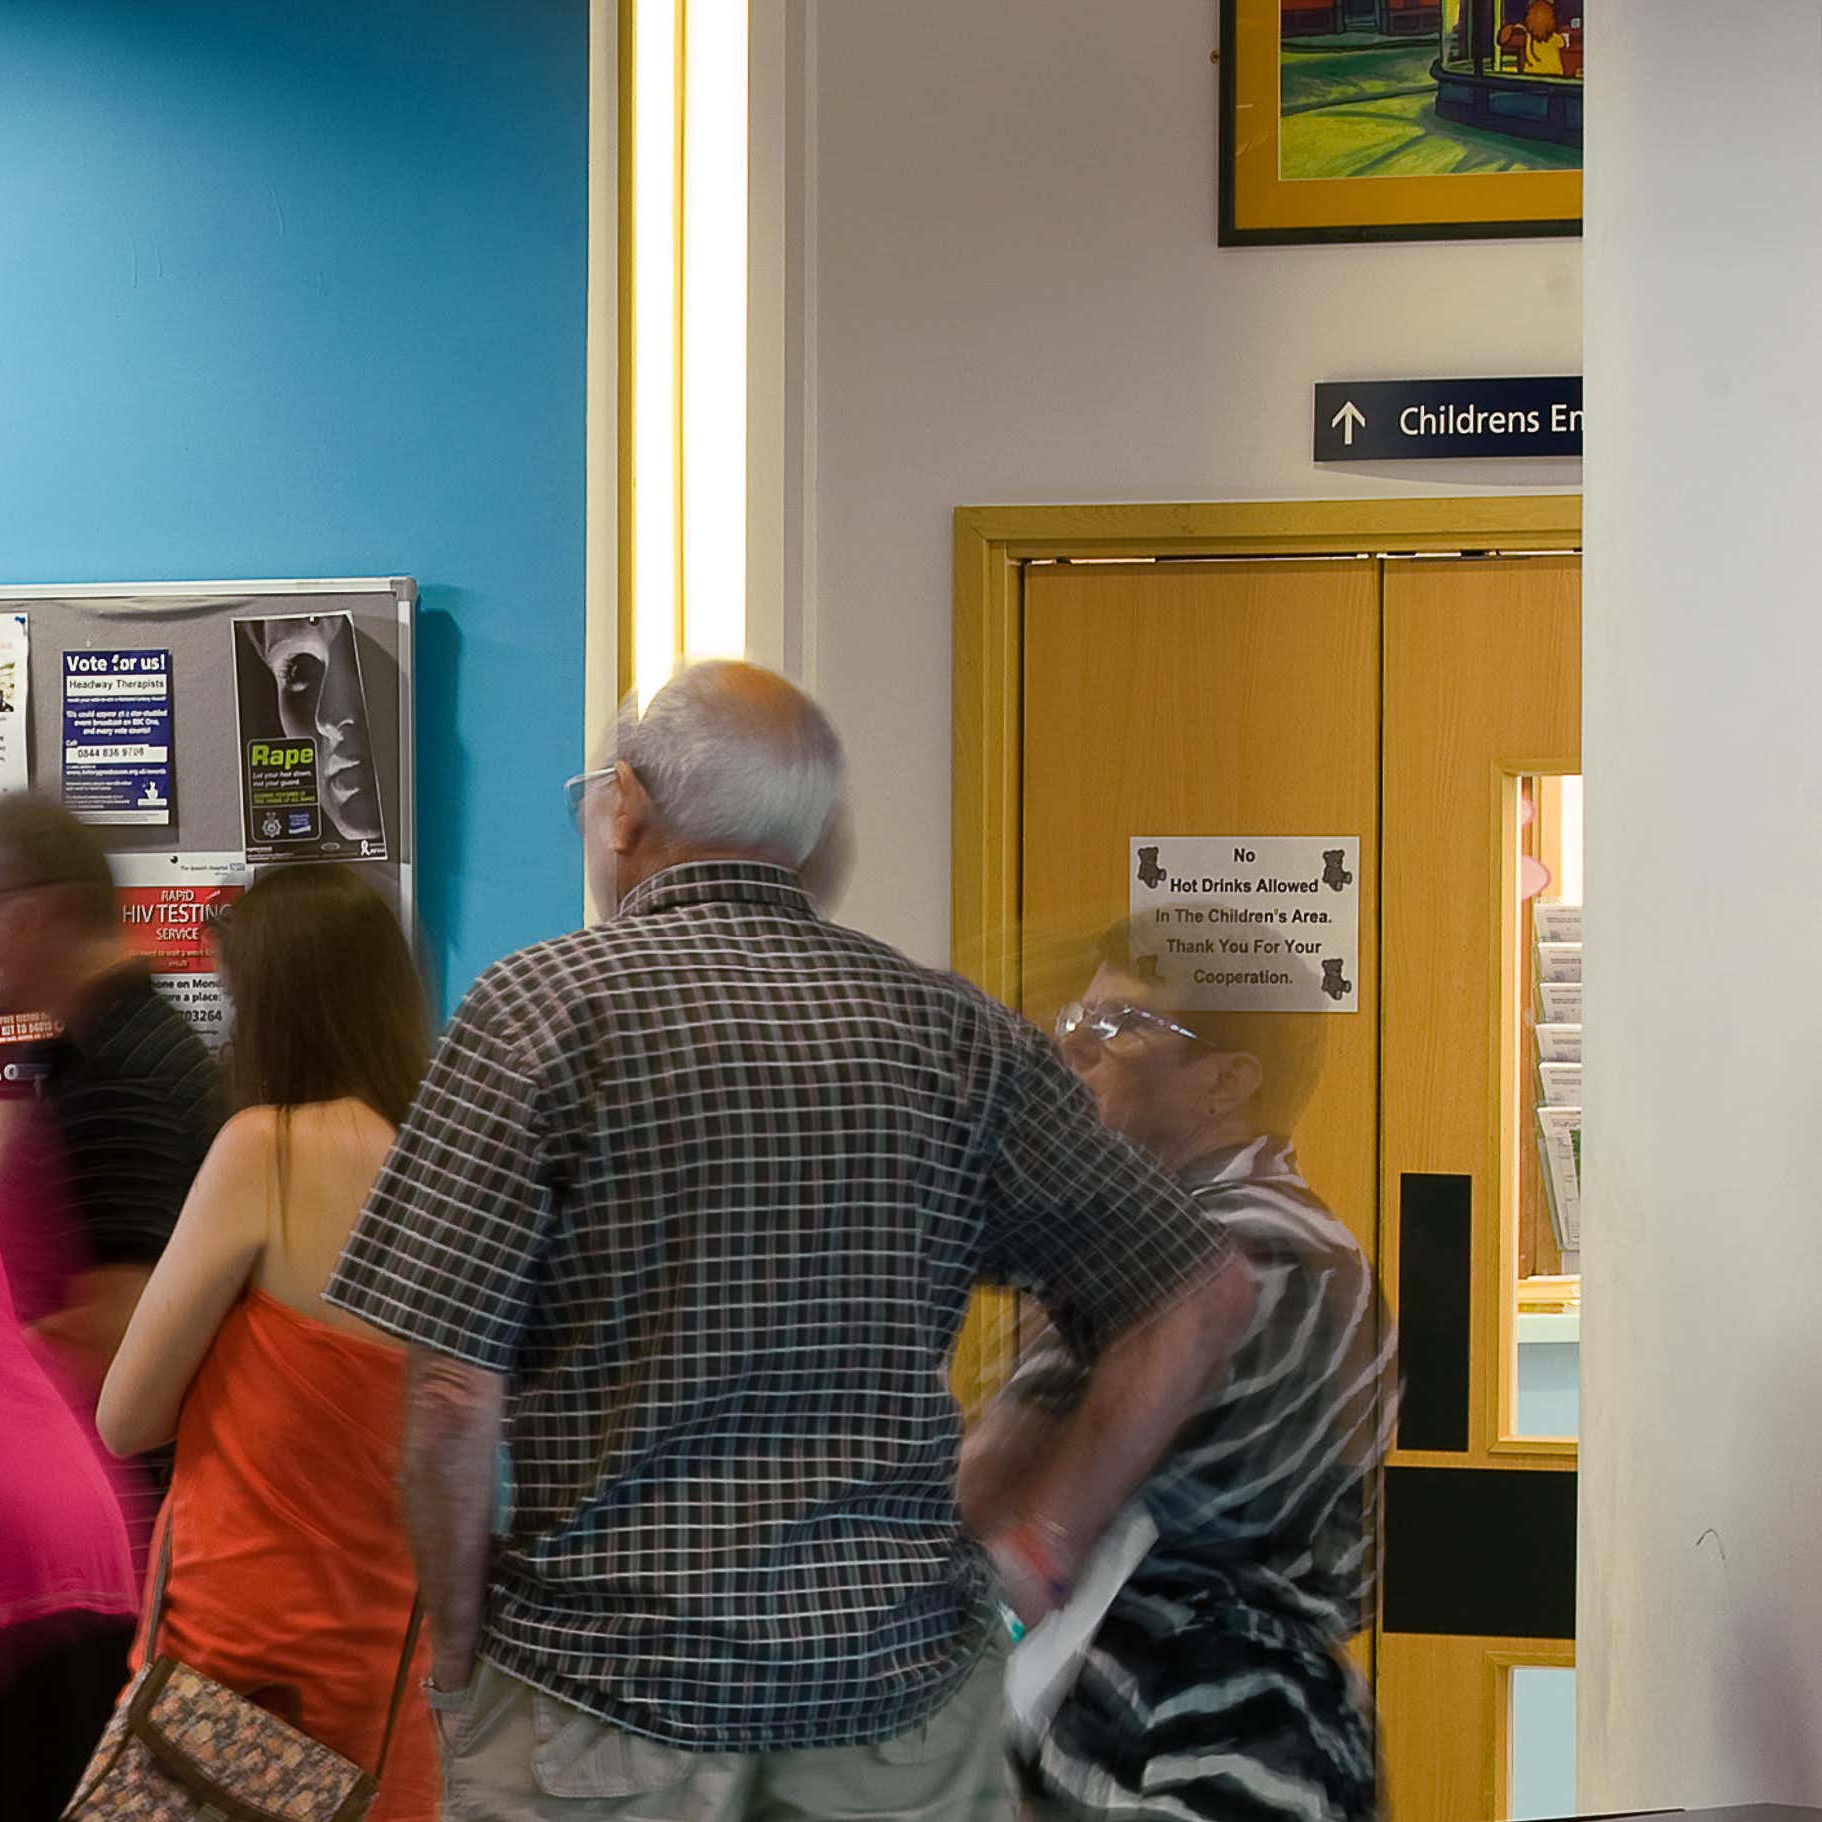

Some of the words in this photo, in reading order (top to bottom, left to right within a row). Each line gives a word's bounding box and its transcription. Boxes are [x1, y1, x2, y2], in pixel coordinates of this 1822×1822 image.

[1400, 404, 1540, 435] Childrens
[67, 656, 108, 671] Vote
[141, 654, 165, 670] us!
[69, 680, 113, 690] Headway
[116, 680, 163, 689] Therapists
[252, 745, 313, 770] Rape
[161, 890, 194, 901] RAPID
[123, 904, 154, 923] HIV
[156, 928, 198, 940] SERVICE
